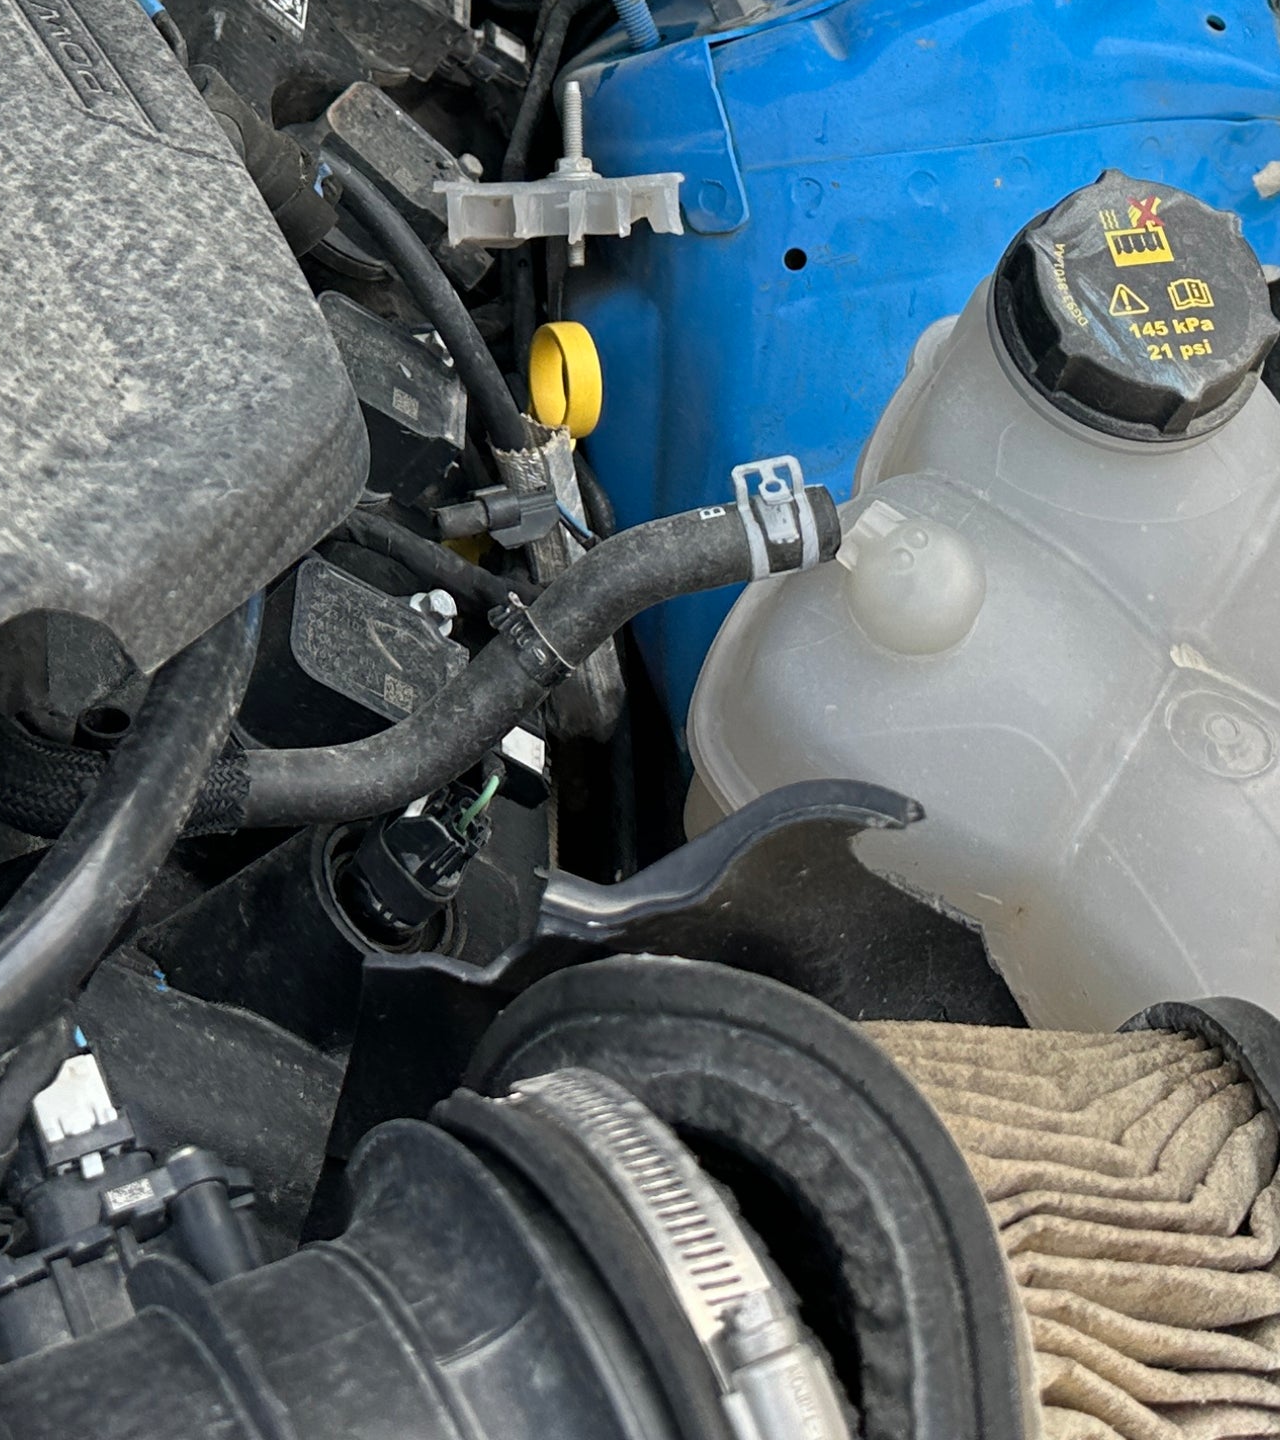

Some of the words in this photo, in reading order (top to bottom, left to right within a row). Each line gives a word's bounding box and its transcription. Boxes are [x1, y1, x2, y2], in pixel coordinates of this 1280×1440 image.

[1129, 319, 1169, 339] 145
[1173, 317, 1215, 335] kPa
[1147, 343, 1173, 361] 21
[1180, 339, 1213, 361] psi
[699, 506, 726, 520] B
